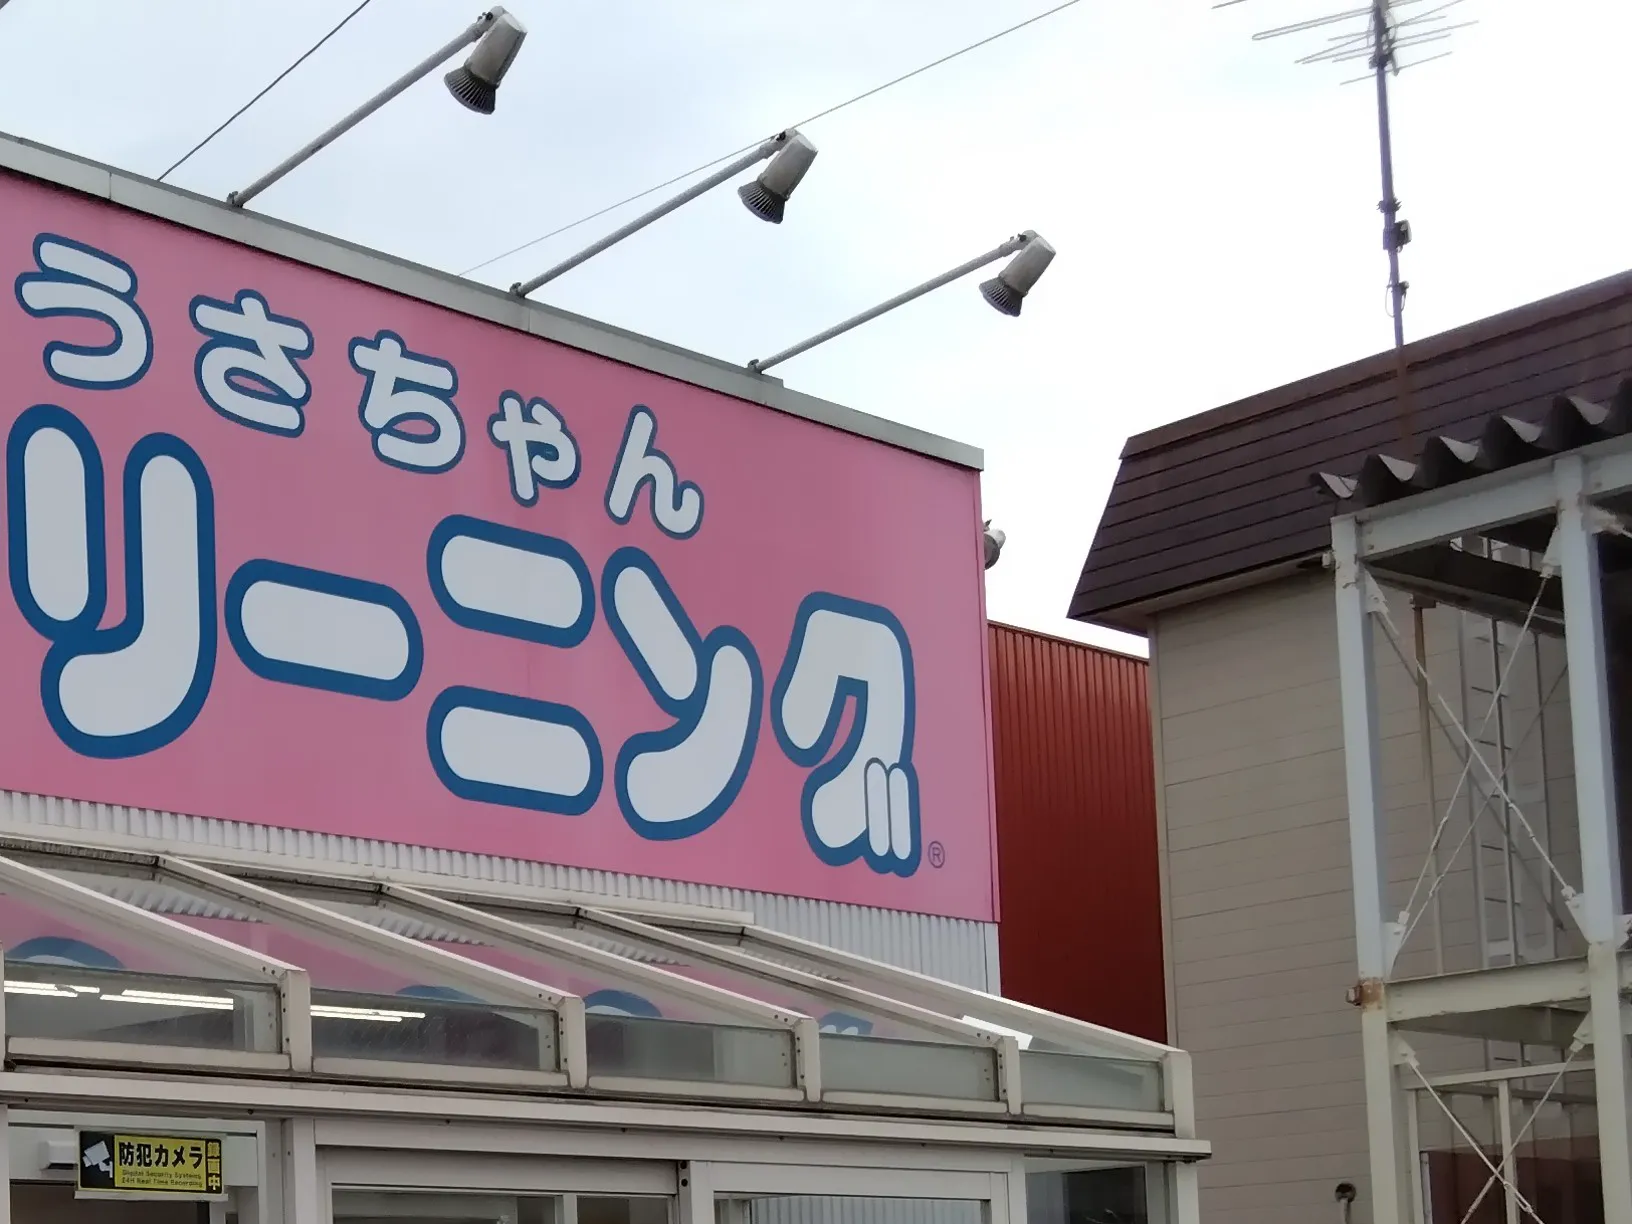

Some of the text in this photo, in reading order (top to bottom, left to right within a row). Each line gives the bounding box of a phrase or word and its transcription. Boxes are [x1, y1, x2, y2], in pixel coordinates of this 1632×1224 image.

[15, 232, 704, 539] うさちゃん
[118, 1141, 204, 1169] 防犯カメラ
